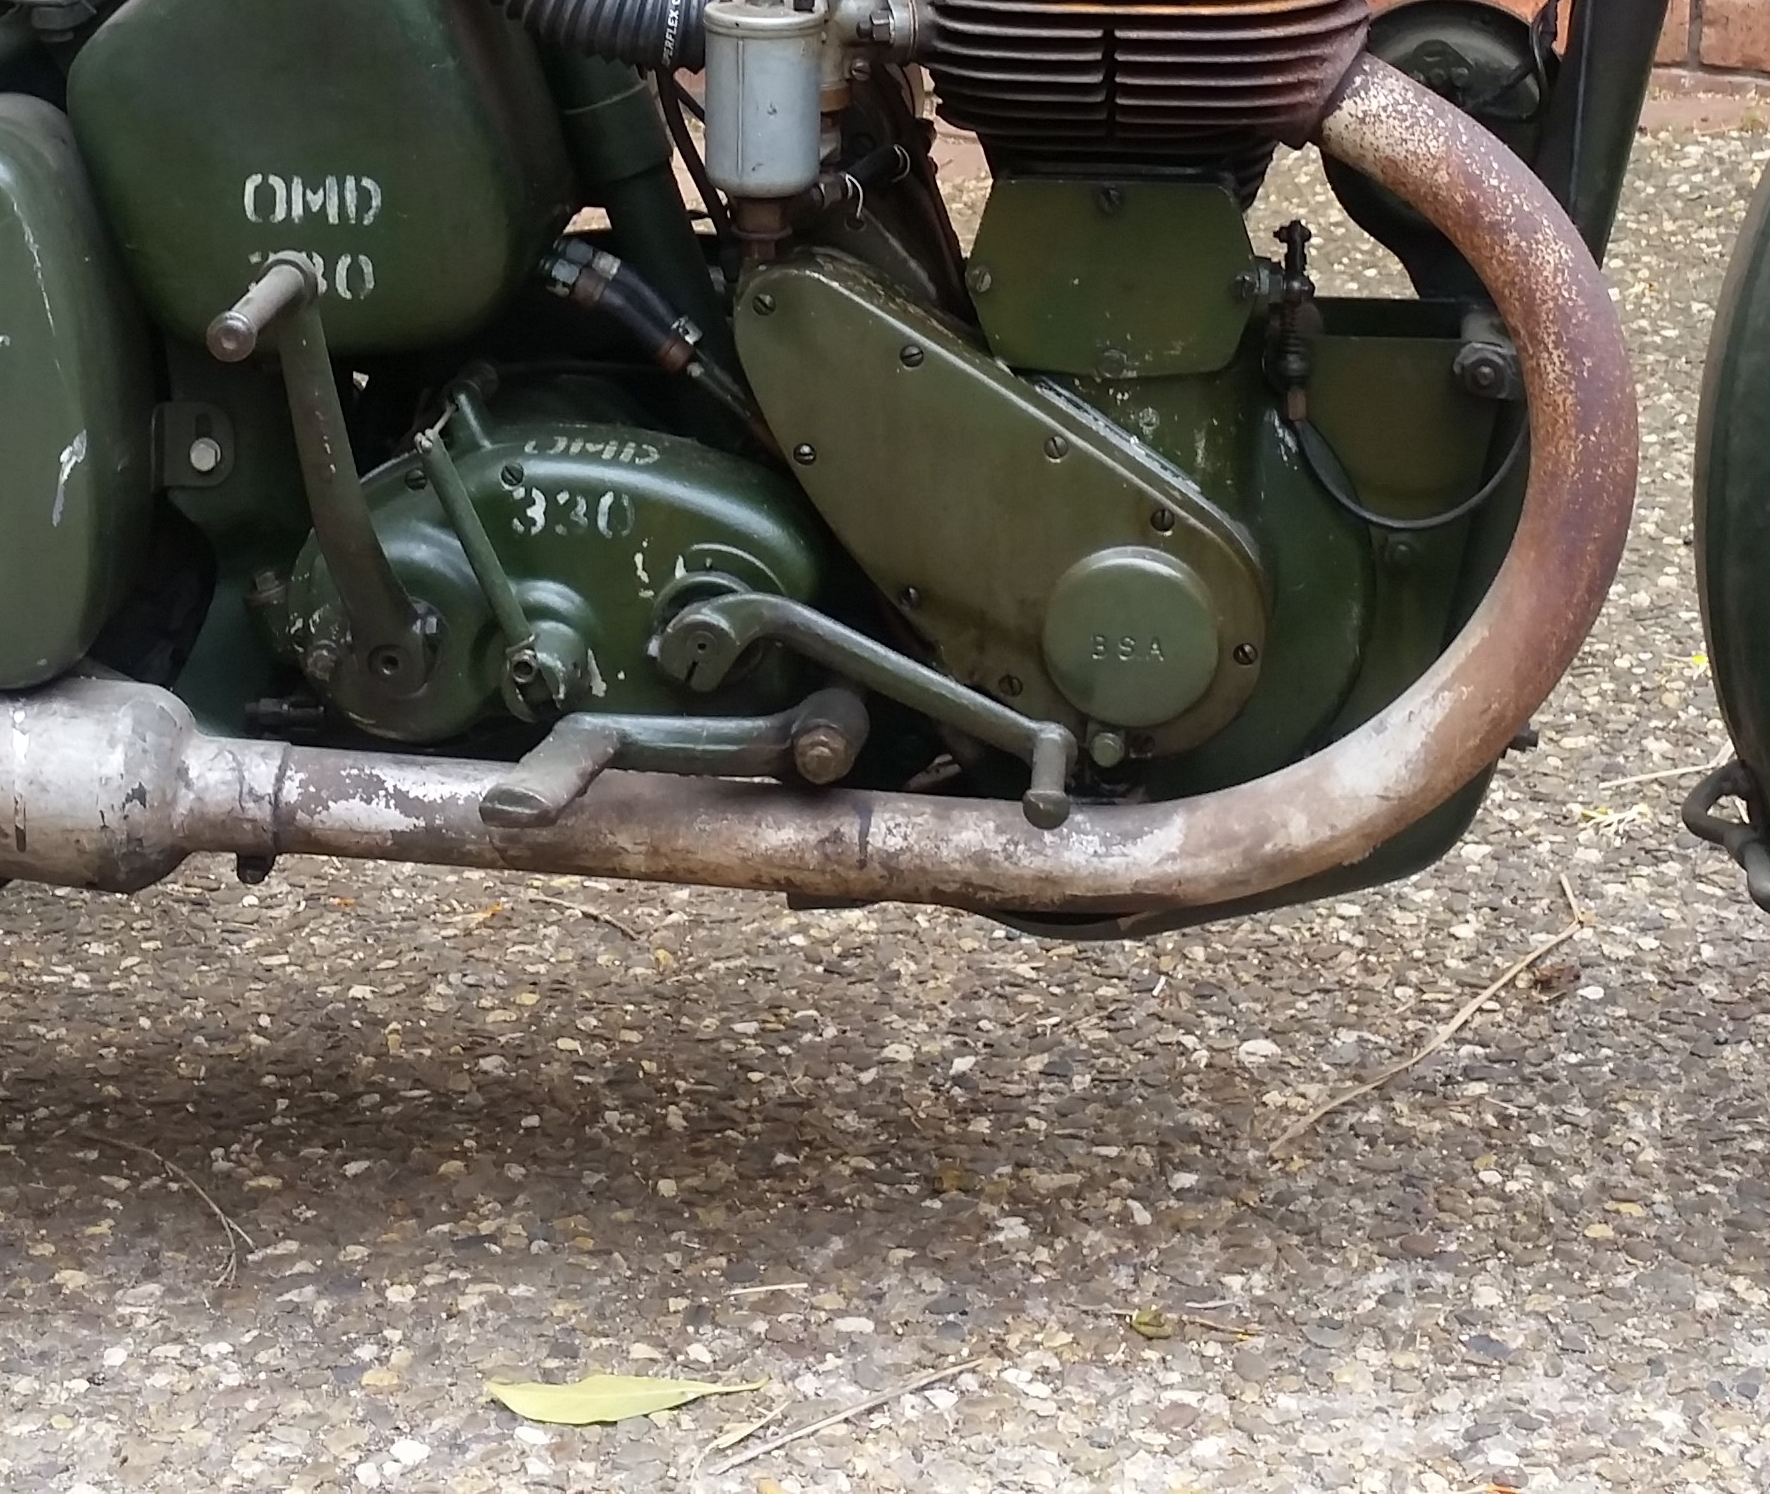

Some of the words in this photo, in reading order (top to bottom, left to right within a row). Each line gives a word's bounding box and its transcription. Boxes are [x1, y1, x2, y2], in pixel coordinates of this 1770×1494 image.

[243, 172, 382, 226] OMD
[511, 486, 635, 539] 330
[1091, 634, 1165, 662] BSA
